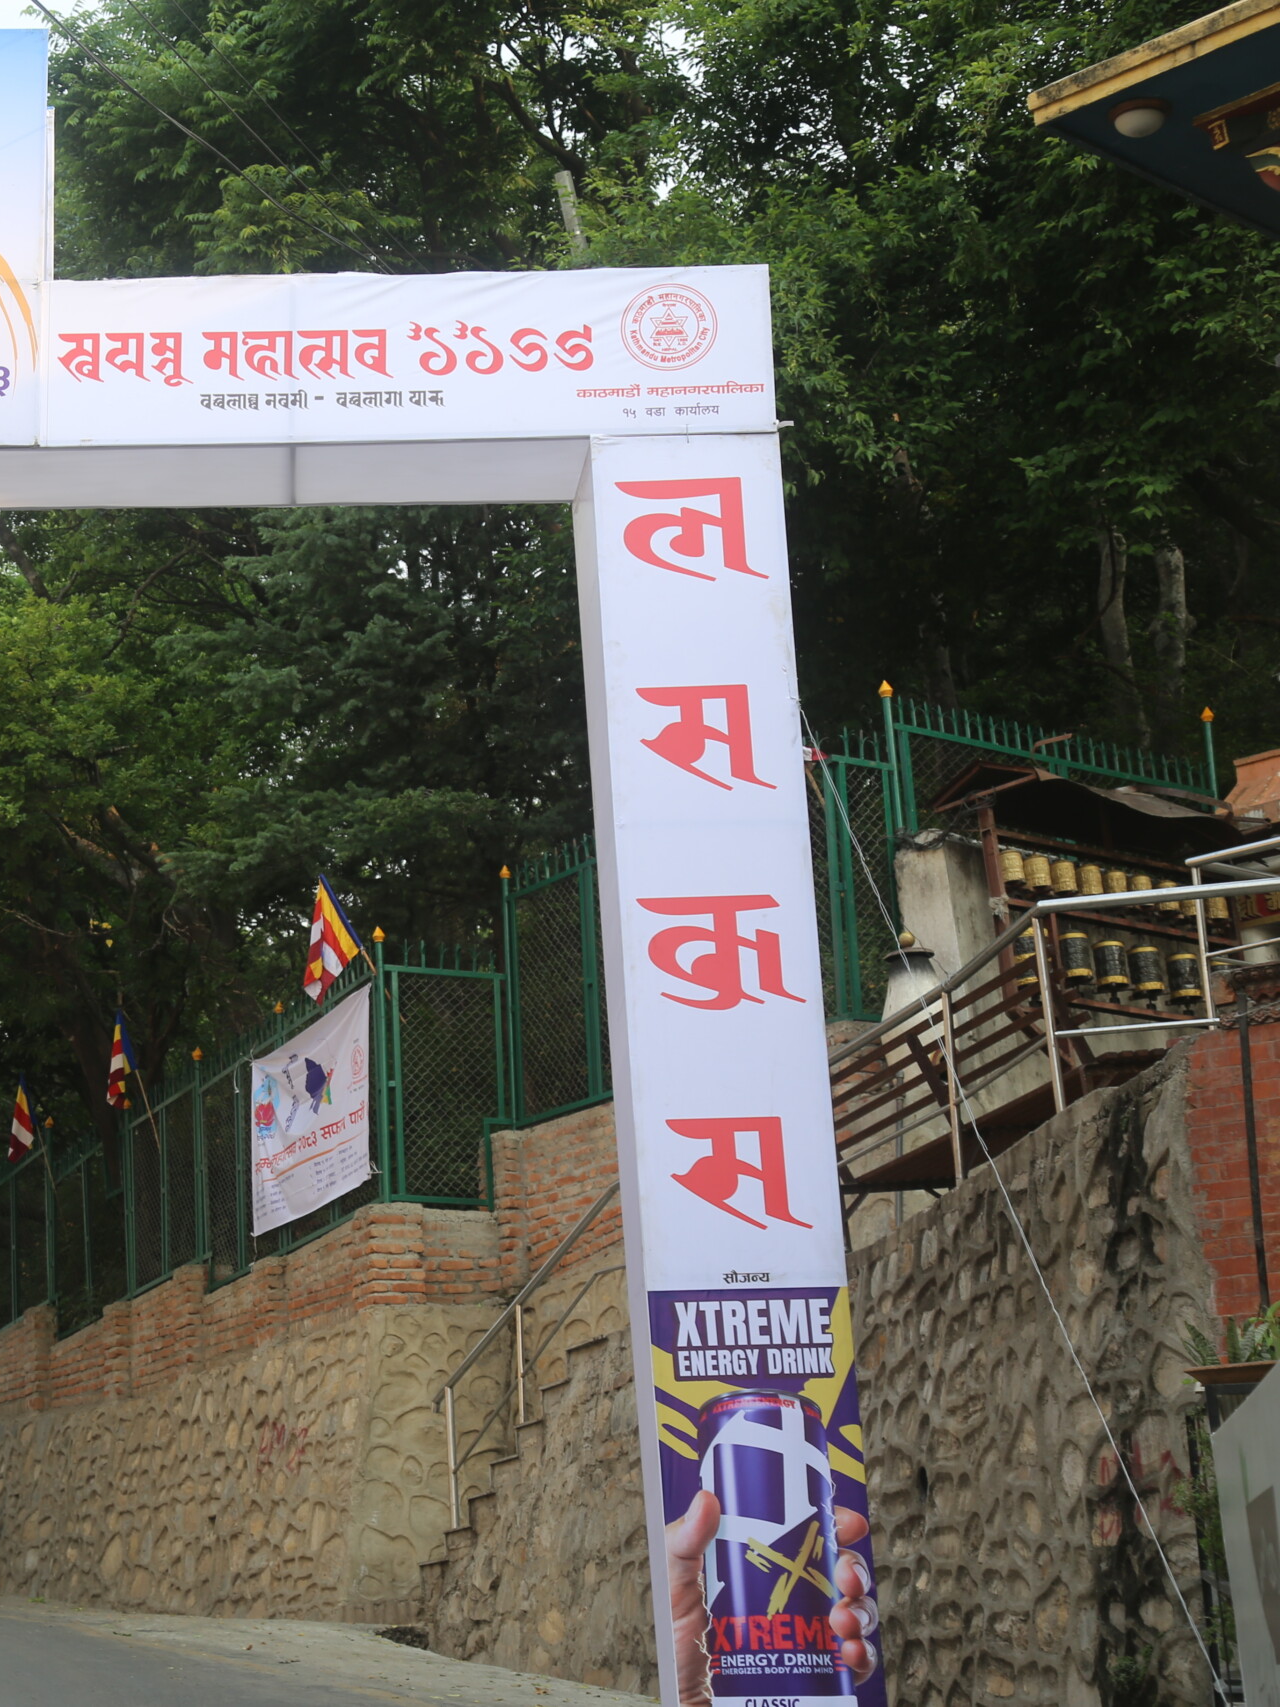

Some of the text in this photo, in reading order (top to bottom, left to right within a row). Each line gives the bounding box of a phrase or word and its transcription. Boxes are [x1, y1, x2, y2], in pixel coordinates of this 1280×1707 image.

[647, 381, 765, 398] महानगरपालिका
[645, 407, 666, 417] वडा
[674, 403, 719, 416] कार्यालय
[723, 1270, 770, 1284] सौजन्य
[674, 1298, 833, 1347] XTREME
[678, 1347, 835, 1377] ENERGY DRINK
[713, 1614, 839, 1652] XTREME
[721, 1653, 833, 1667] ENERGY DRINK
[722, 1667, 762, 1675] ENERGIZES
